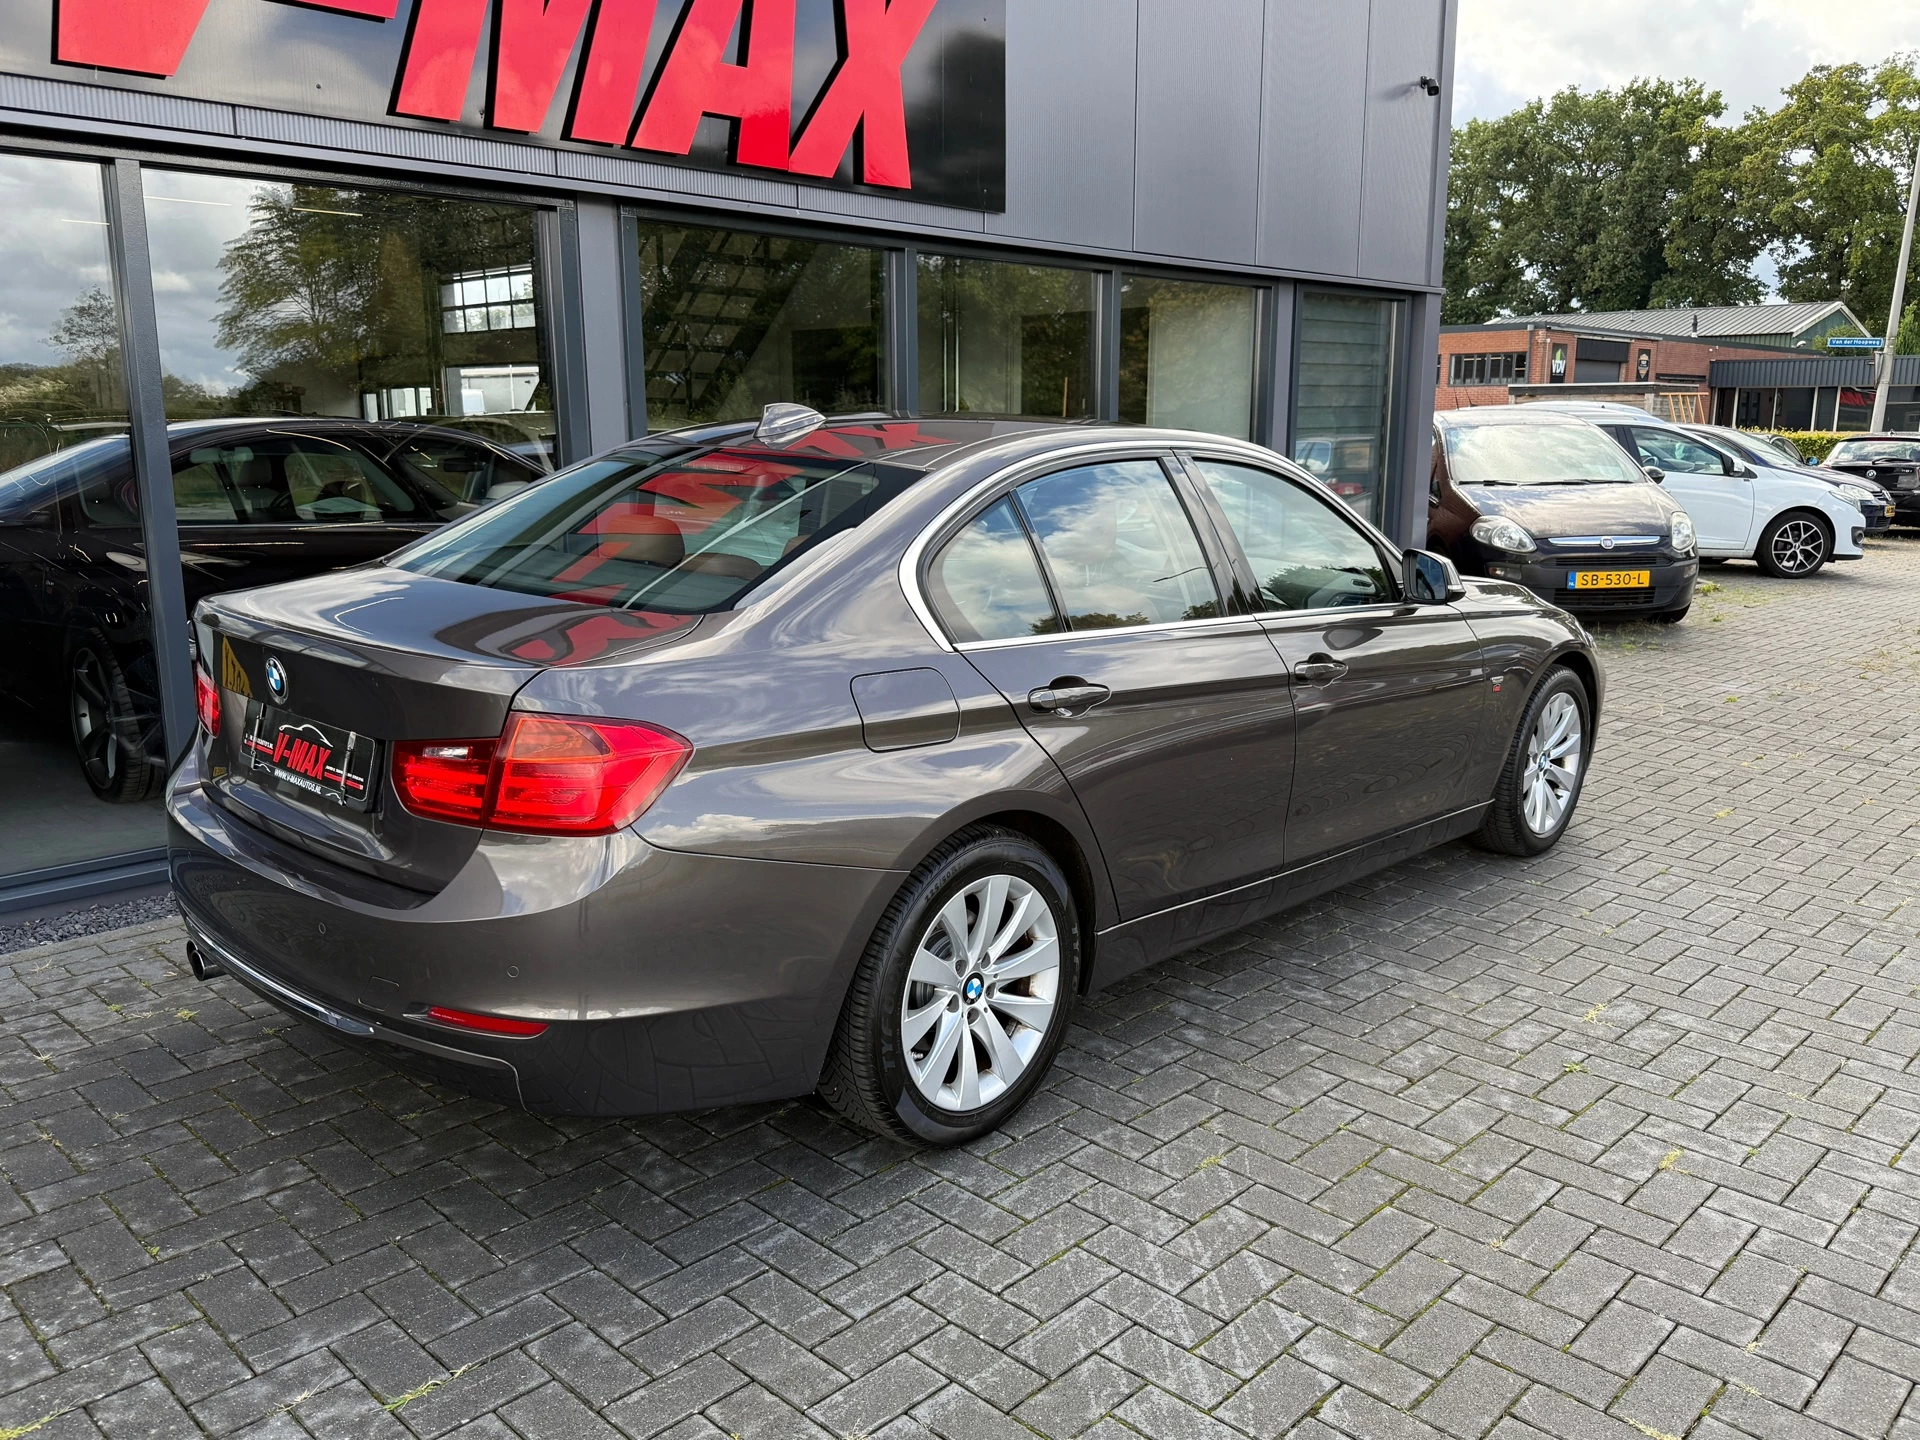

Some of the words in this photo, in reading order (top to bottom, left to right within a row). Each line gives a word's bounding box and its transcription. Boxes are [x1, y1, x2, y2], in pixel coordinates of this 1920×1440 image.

[54, 0, 938, 189] MAX
[1552, 359, 1566, 374] VDV
[1580, 573, 1644, 586] SB-530-L
[272, 732, 331, 781] V-MAX
